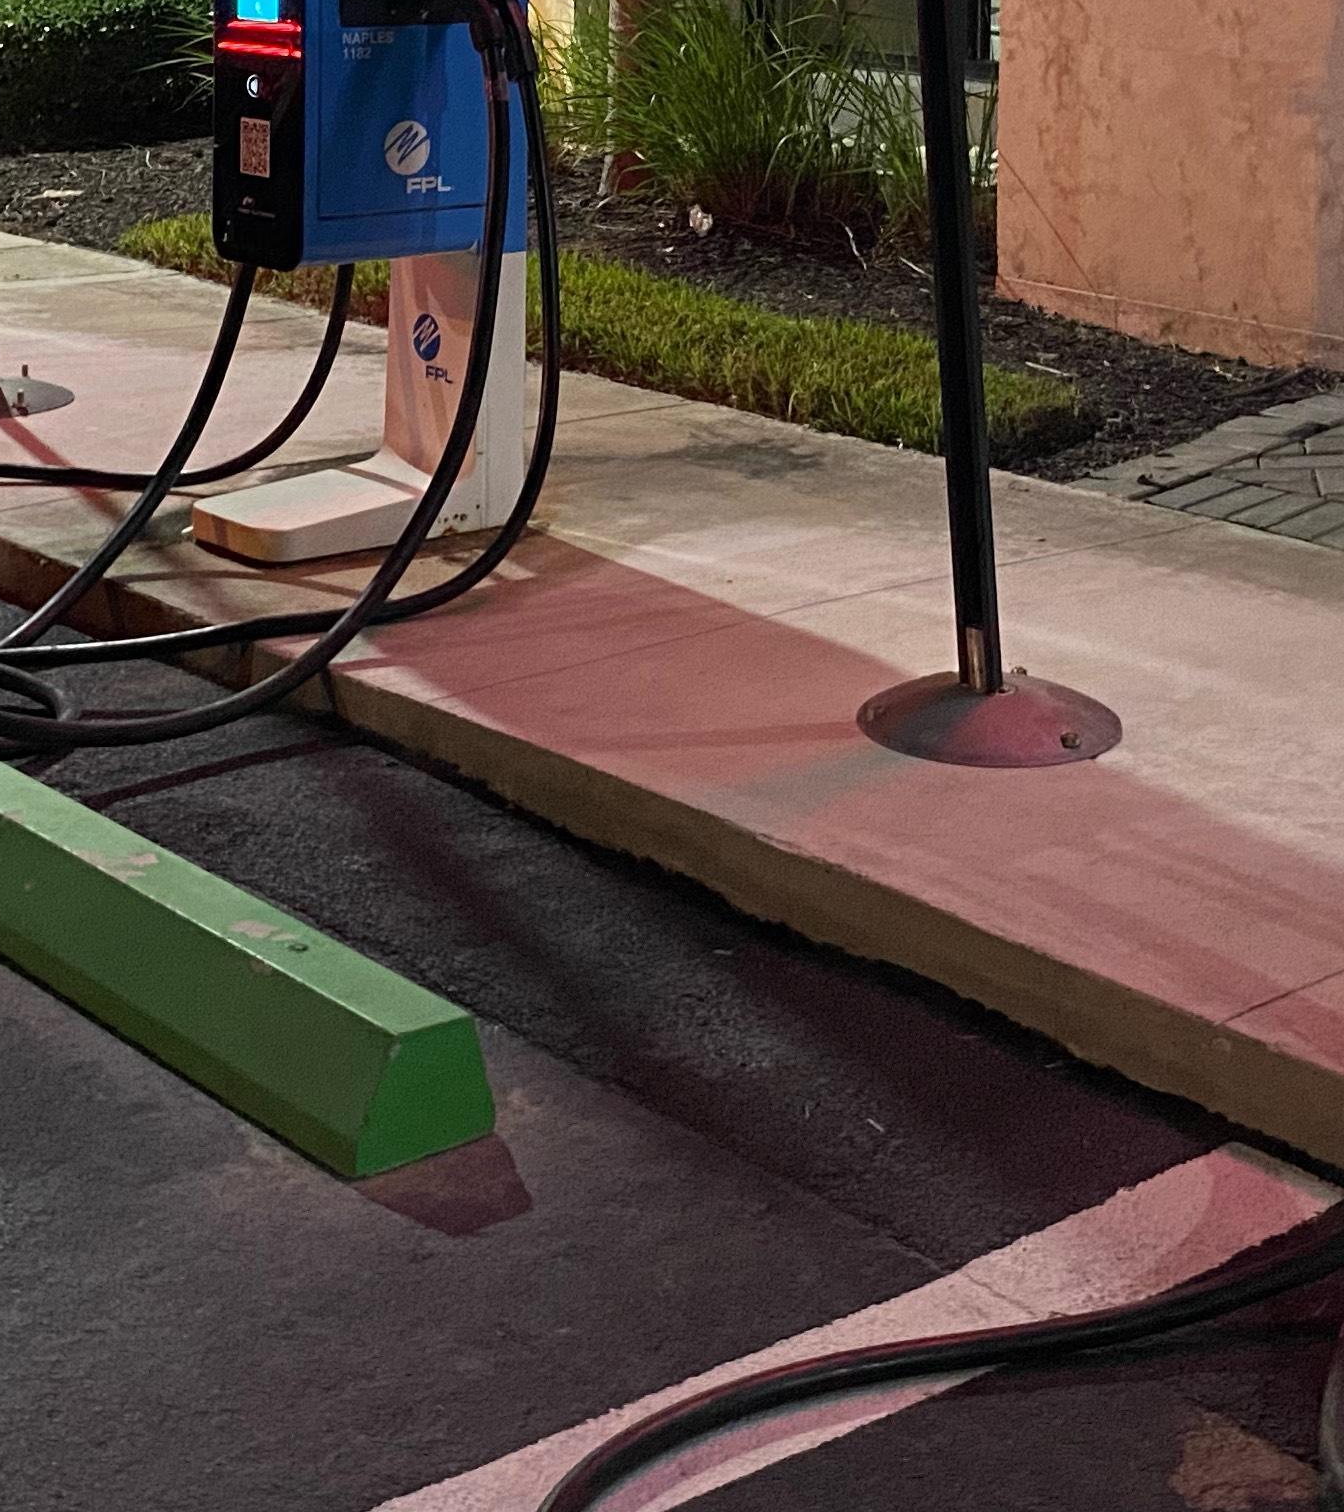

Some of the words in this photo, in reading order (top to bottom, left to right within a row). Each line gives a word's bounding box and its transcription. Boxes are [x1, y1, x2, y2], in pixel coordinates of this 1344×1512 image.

[342, 31, 395, 45] NAPLES
[407, 176, 452, 193] FPL
[425, 365, 453, 384] FPL
